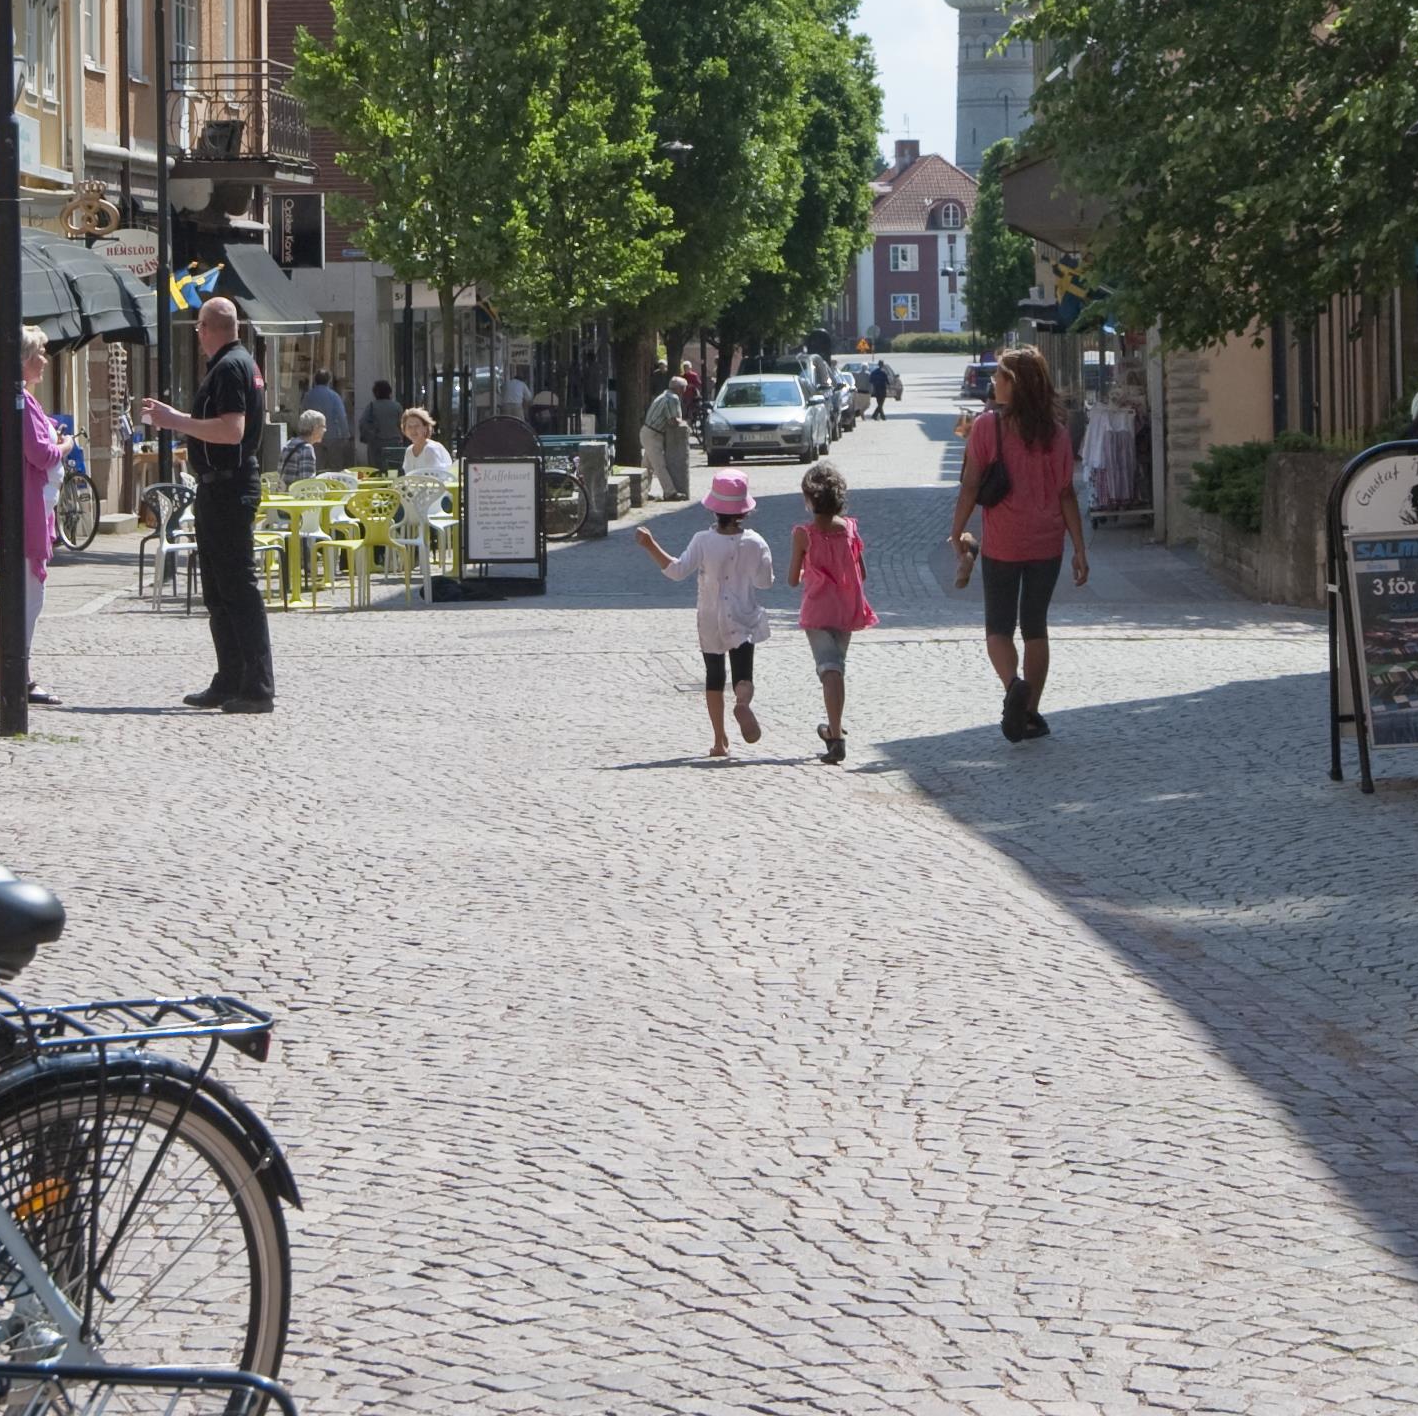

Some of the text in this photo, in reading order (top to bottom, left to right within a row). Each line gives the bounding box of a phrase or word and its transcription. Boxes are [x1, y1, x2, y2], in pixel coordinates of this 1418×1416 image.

[106, 244, 155, 257] HEMSLÖJD
[1356, 463, 1400, 506] Gustaf
[1372, 578, 1384, 596] 3
[1388, 577, 1416, 595] för
